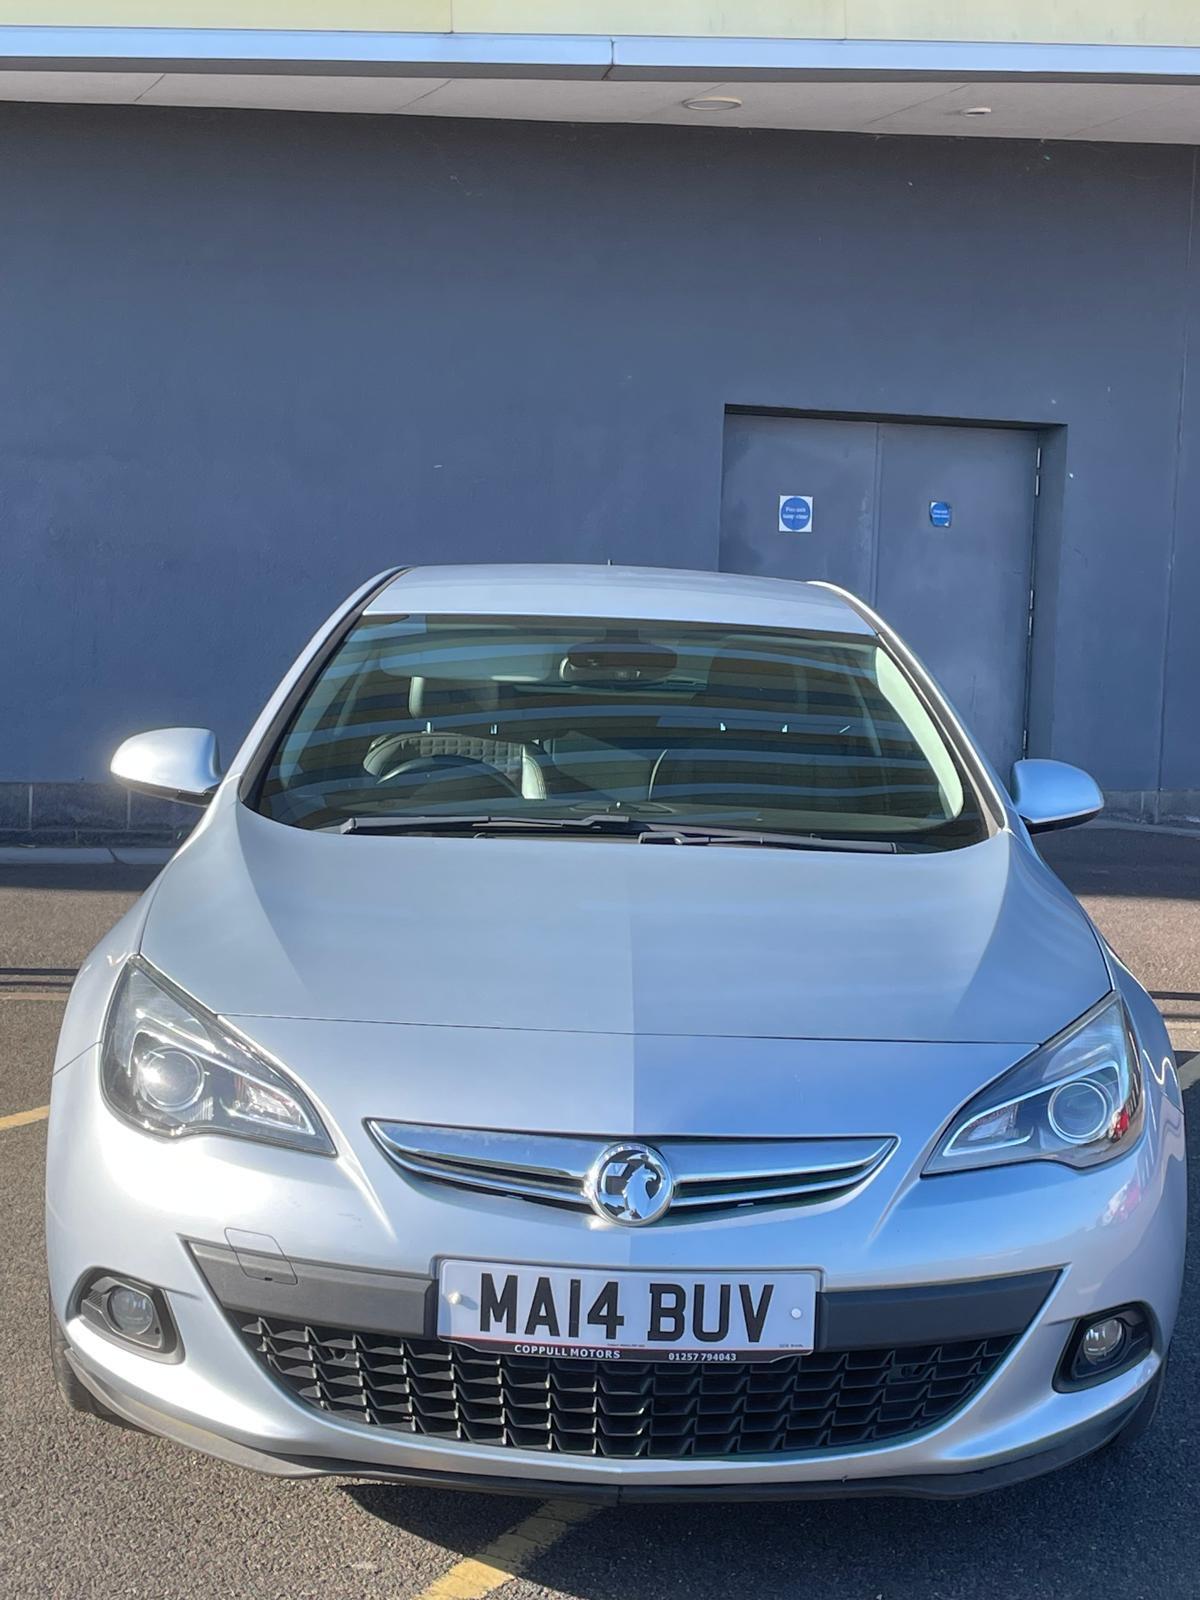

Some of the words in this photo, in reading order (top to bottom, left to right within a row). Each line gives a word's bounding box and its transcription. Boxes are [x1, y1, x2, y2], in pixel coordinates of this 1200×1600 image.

[480, 1273, 625, 1340] MA14
[647, 1283, 775, 1343] BUV
[514, 1344, 568, 1357] COPPULL
[570, 1348, 621, 1359] MOTORS
[668, 1353, 699, 1361] 01257
[701, 1353, 737, 1361] 794043
